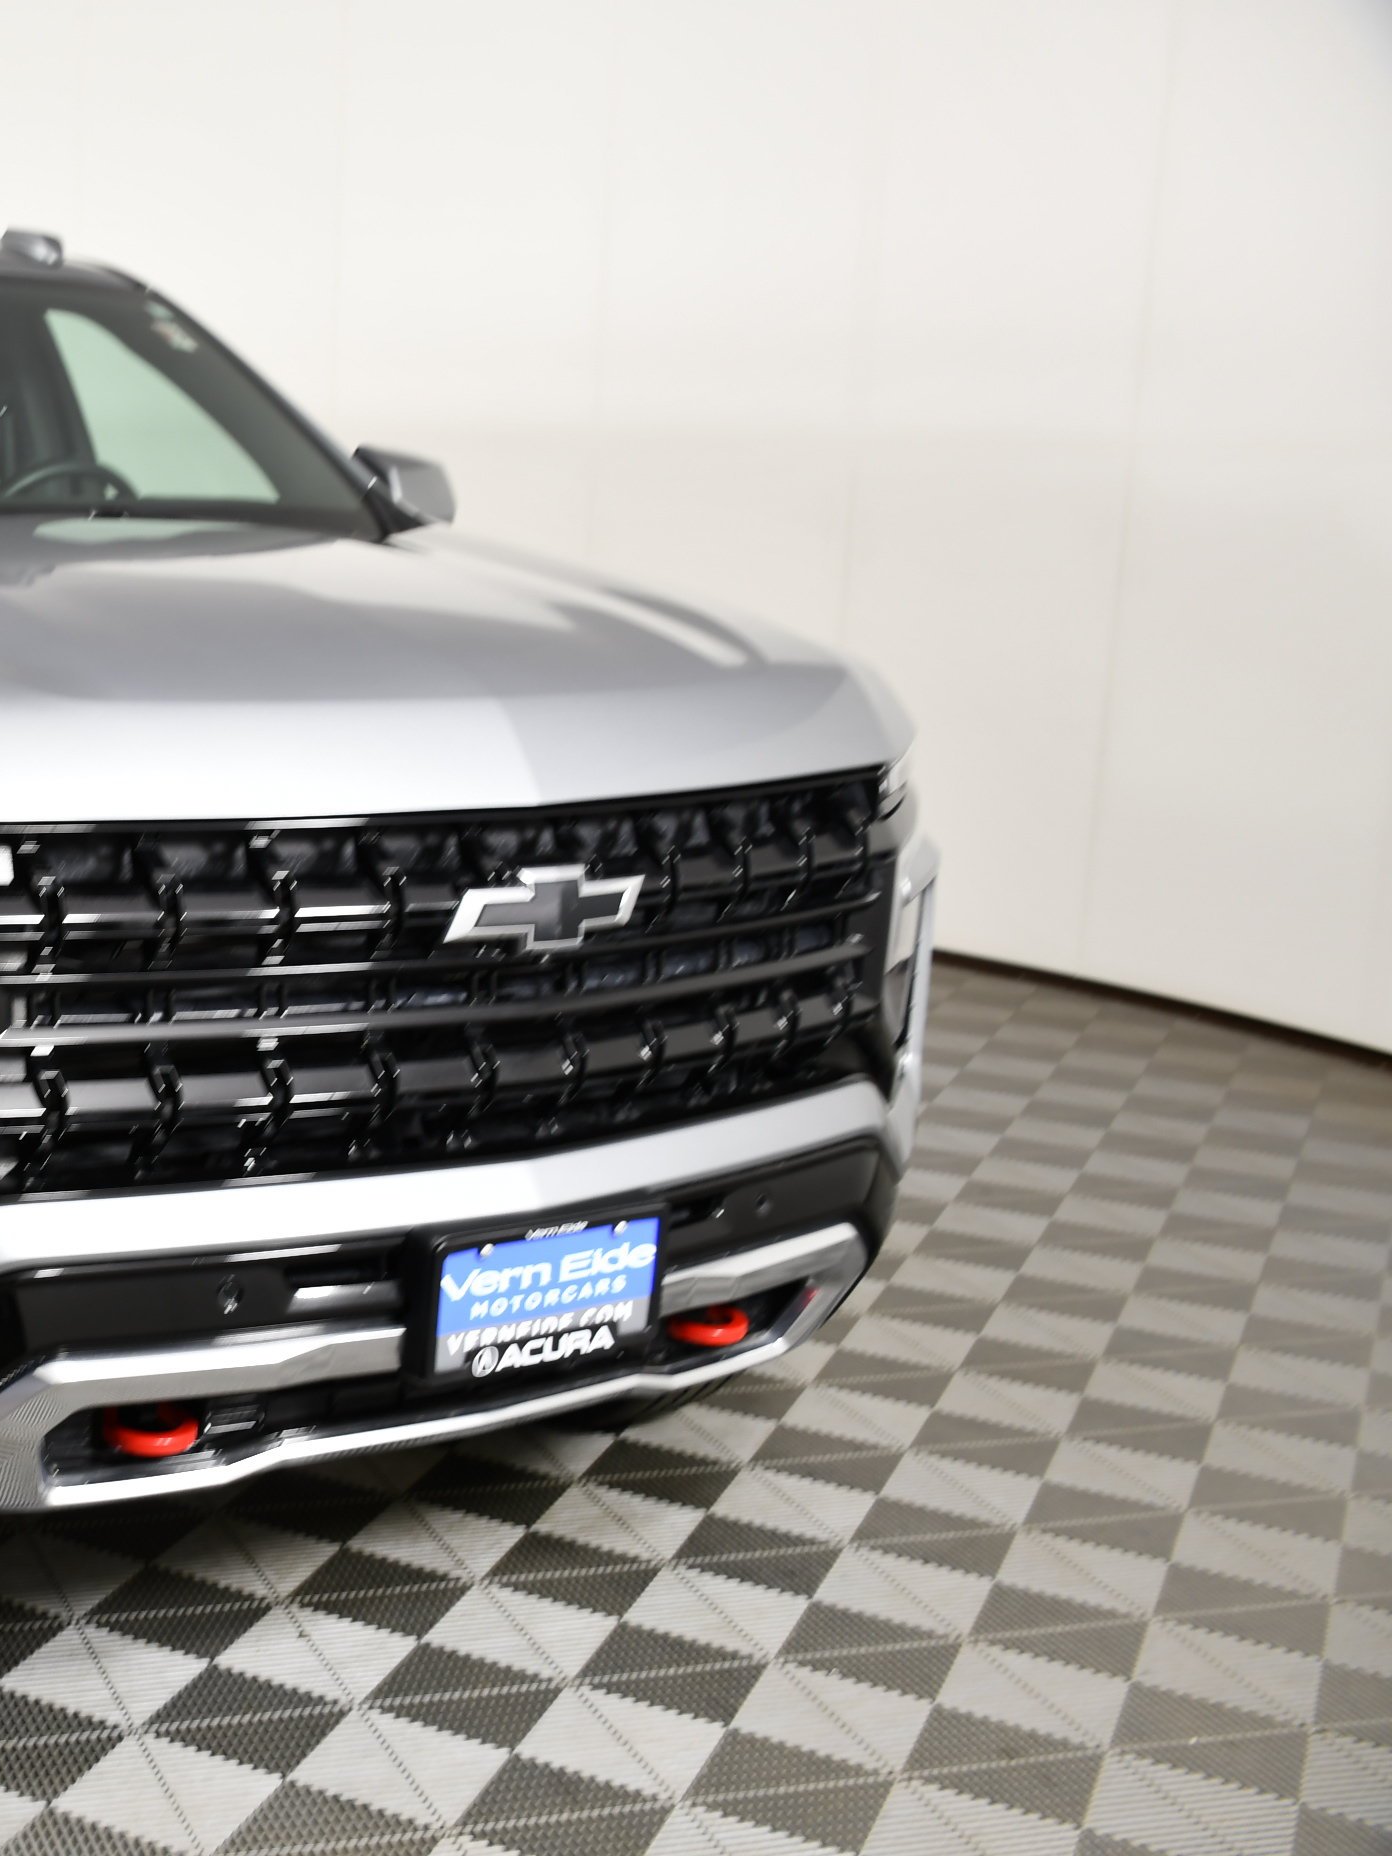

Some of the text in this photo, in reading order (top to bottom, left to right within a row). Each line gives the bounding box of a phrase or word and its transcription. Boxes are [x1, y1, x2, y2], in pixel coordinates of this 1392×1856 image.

[440, 1242, 657, 1302] Vern Eide
[469, 1275, 627, 1320] MOTORCARS
[495, 1325, 615, 1373] ACURA
